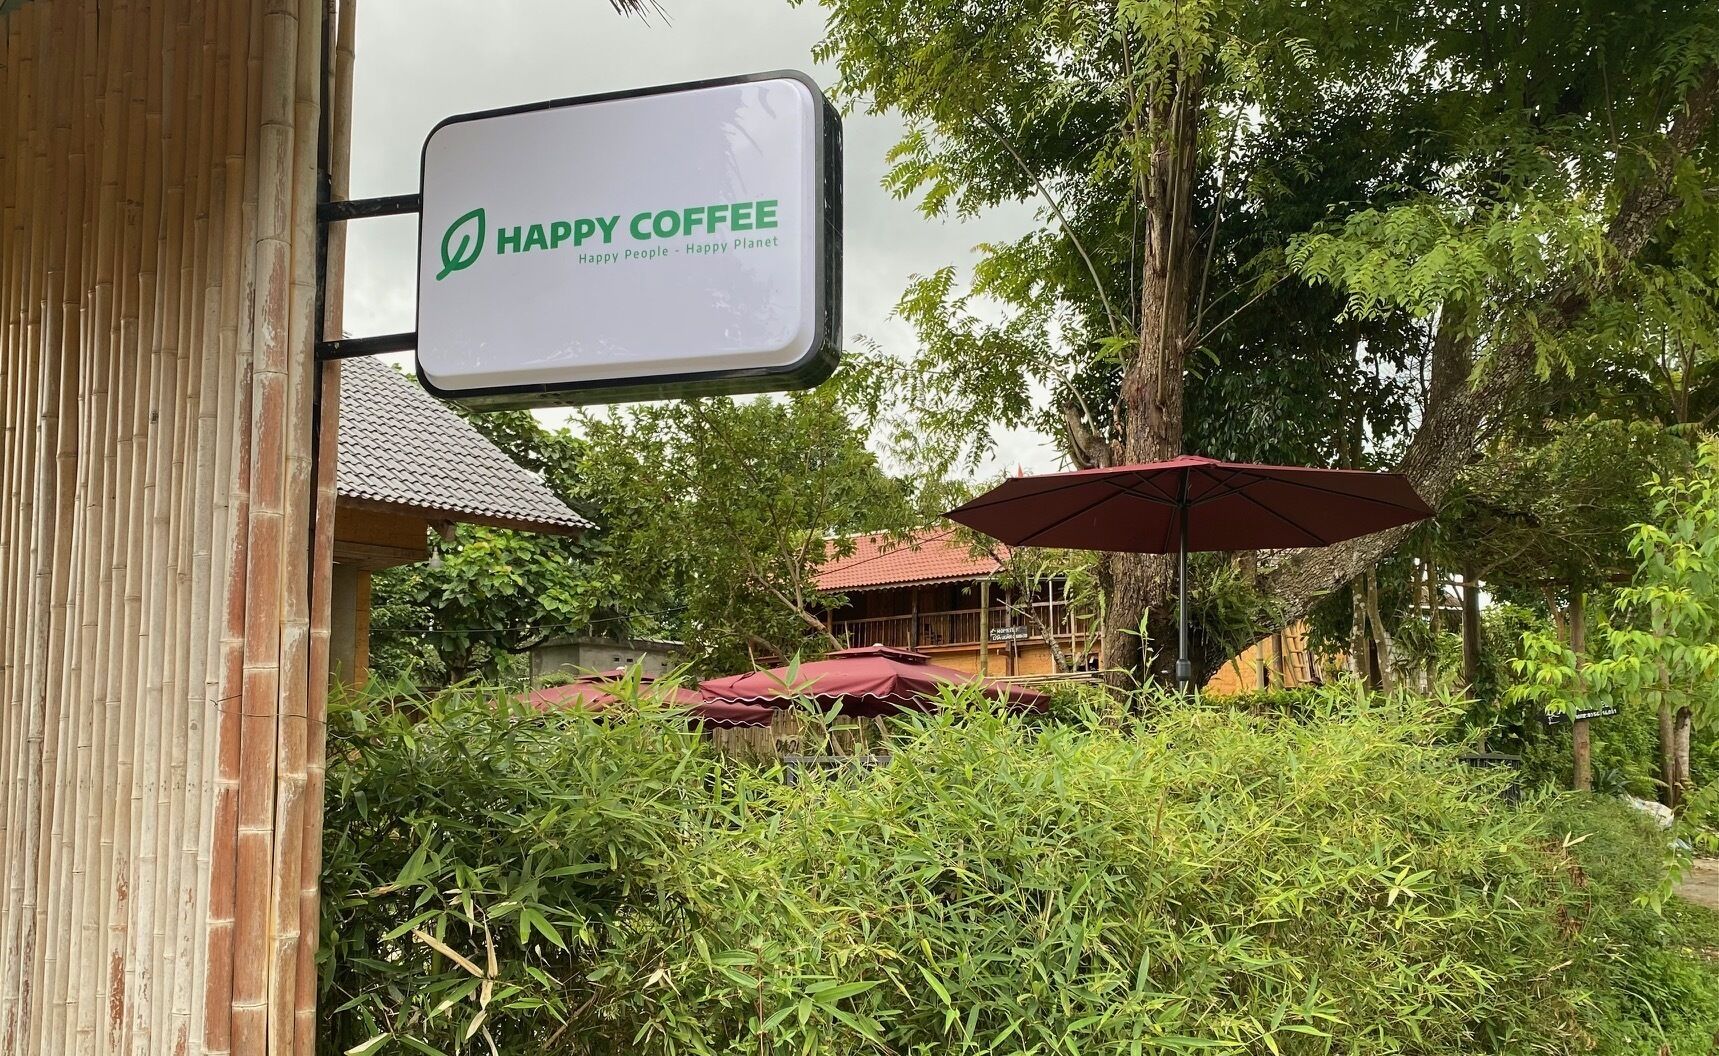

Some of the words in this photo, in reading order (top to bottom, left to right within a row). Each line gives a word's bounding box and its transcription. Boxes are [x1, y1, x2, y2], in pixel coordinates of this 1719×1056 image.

[496, 215, 621, 255] HAPPY
[629, 200, 778, 240] COFFEE
[578, 252, 619, 264] Happy
[624, 246, 669, 260] People
[686, 242, 728, 255] Happy
[734, 236, 779, 249] Planet
